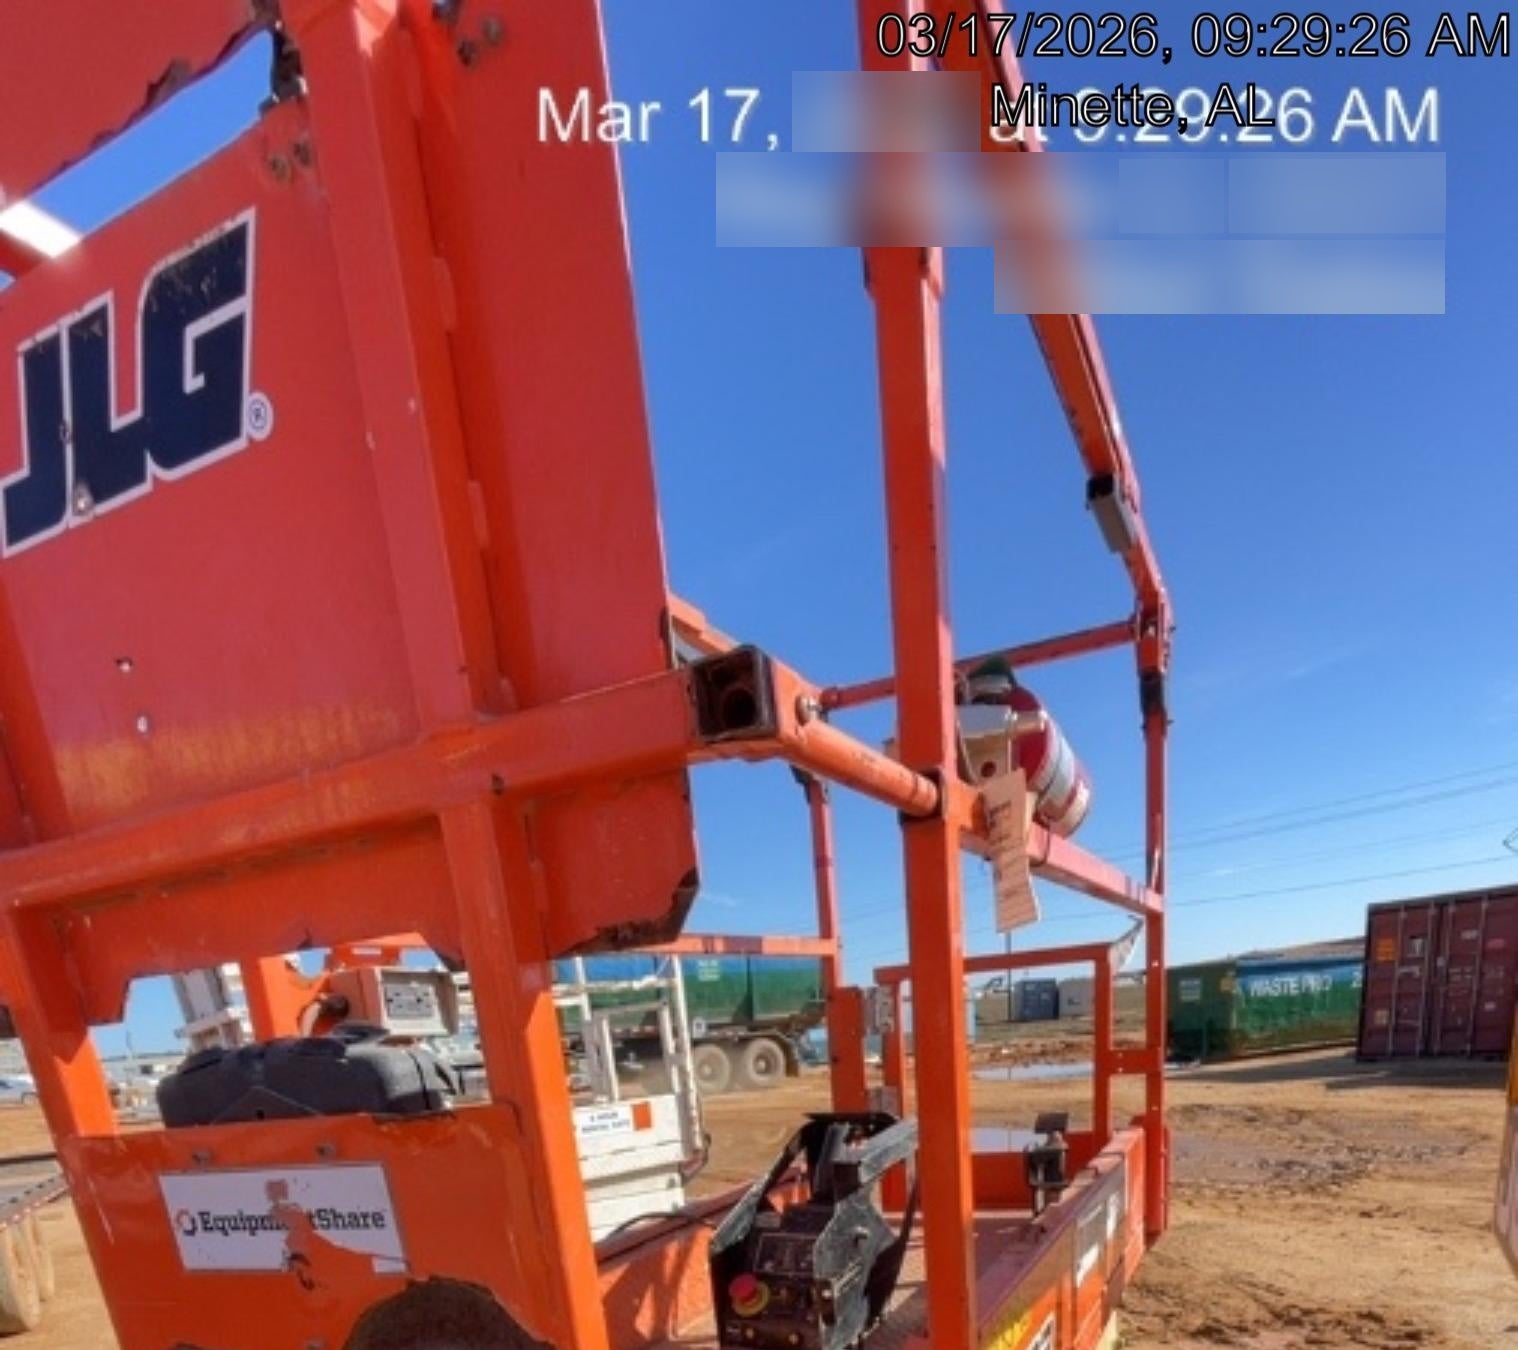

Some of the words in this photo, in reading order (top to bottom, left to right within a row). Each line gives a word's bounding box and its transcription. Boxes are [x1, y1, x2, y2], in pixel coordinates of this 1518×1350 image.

[0, 206, 255, 558] JLG
[1250, 975, 1300, 998] WASTE
[197, 1207, 386, 1236] EquipmtShare
